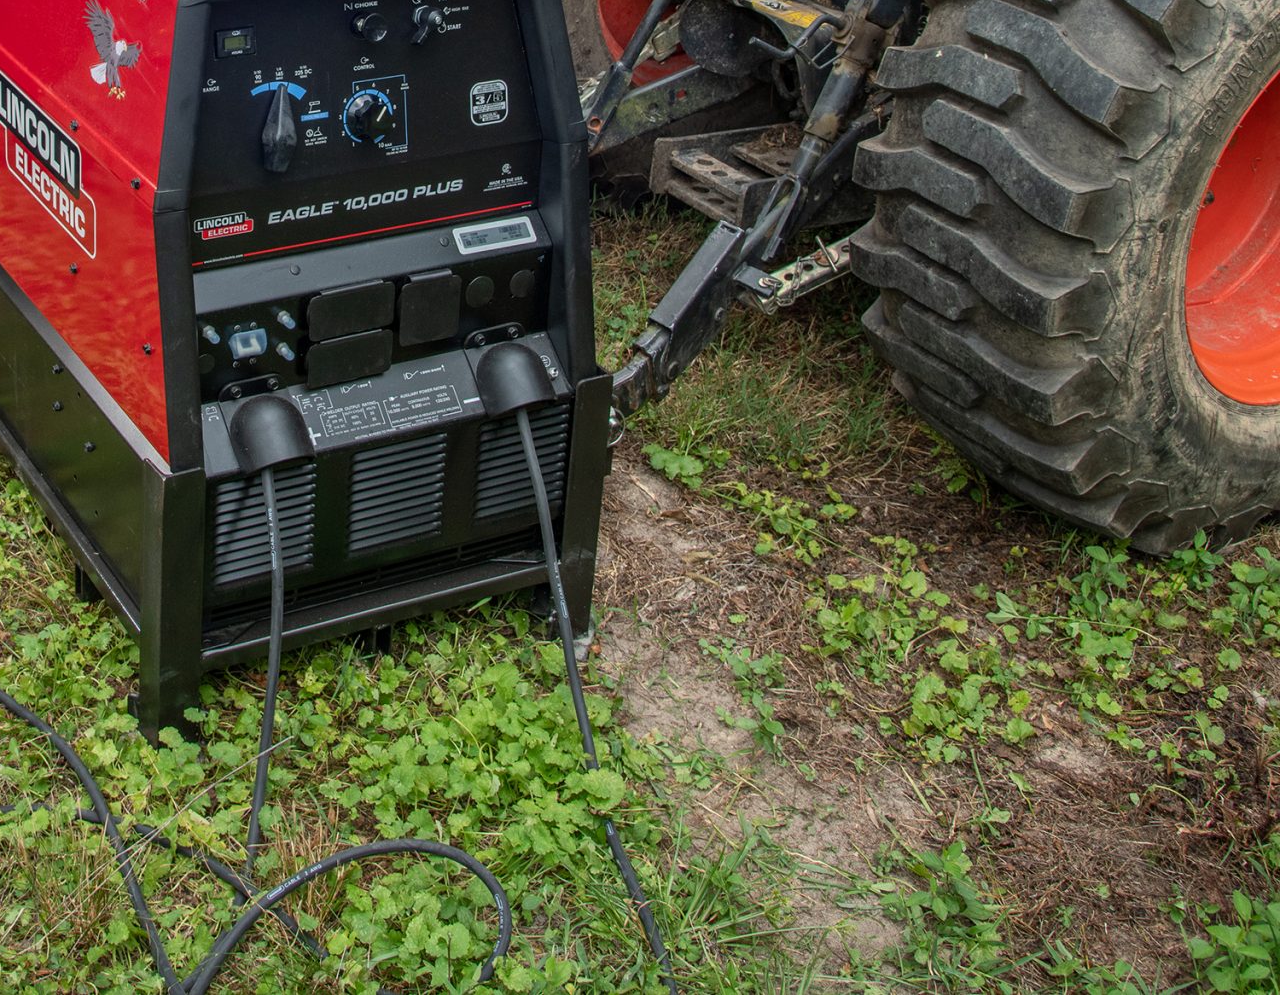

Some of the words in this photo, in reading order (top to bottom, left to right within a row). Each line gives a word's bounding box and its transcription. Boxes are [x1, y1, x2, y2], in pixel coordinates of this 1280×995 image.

[354, 0, 378, 9] CHOKE
[447, 23, 461, 31] START
[15, 142, 86, 239] ELECTRIC
[268, 202, 334, 225] EAGLE
[343, 188, 408, 213] 10,000
[413, 178, 463, 200] PLUS
[197, 214, 243, 231] LINCOLN
[208, 224, 248, 237] ELECTRIC
[285, 875, 301, 888] CABLE
[309, 863, 323, 874] AWG
